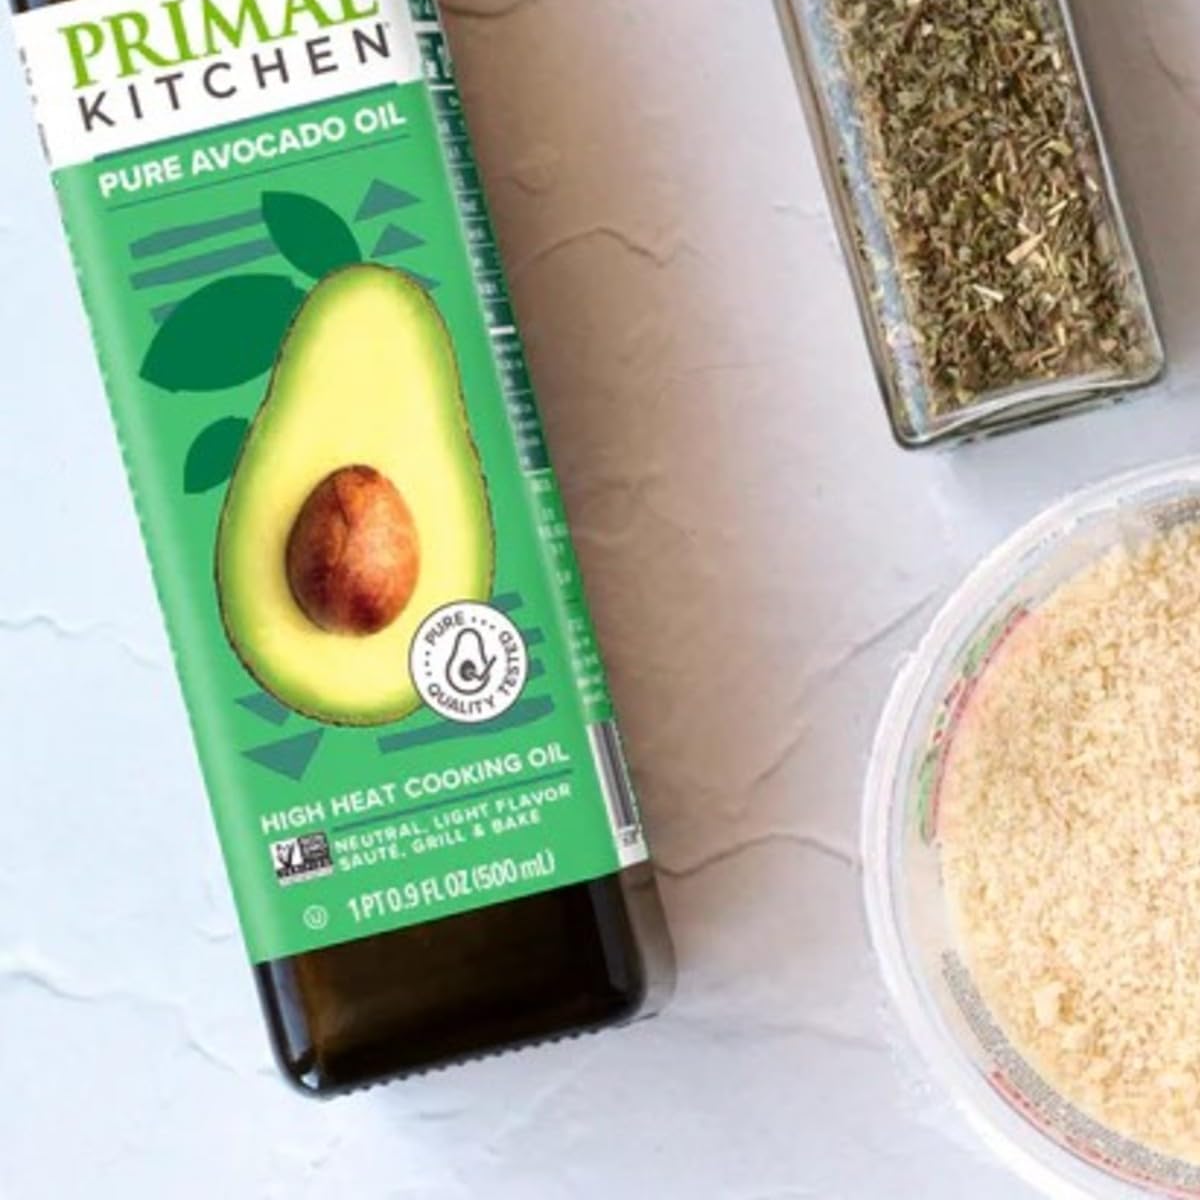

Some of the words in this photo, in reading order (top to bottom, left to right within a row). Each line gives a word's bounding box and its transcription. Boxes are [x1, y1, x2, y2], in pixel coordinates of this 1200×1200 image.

[78, 24, 391, 132] KITCHEN
[99, 157, 185, 198] PURE
[191, 117, 346, 176] AVOCADO
[354, 102, 408, 134] OIL
[424, 610, 465, 646] PURE
[427, 683, 495, 714] QUALITY
[497, 630, 520, 696] TESTED
[261, 803, 326, 835] HIGH
[331, 783, 397, 817] HEAT
[404, 753, 523, 799] COOKING
[527, 742, 571, 768] OIL
[433, 803, 489, 830] LIGHT
[495, 782, 572, 812] FLAVOR
[411, 830, 467, 854] GRILL
[472, 824, 486, 839] &
[492, 808, 541, 834] BAKE
